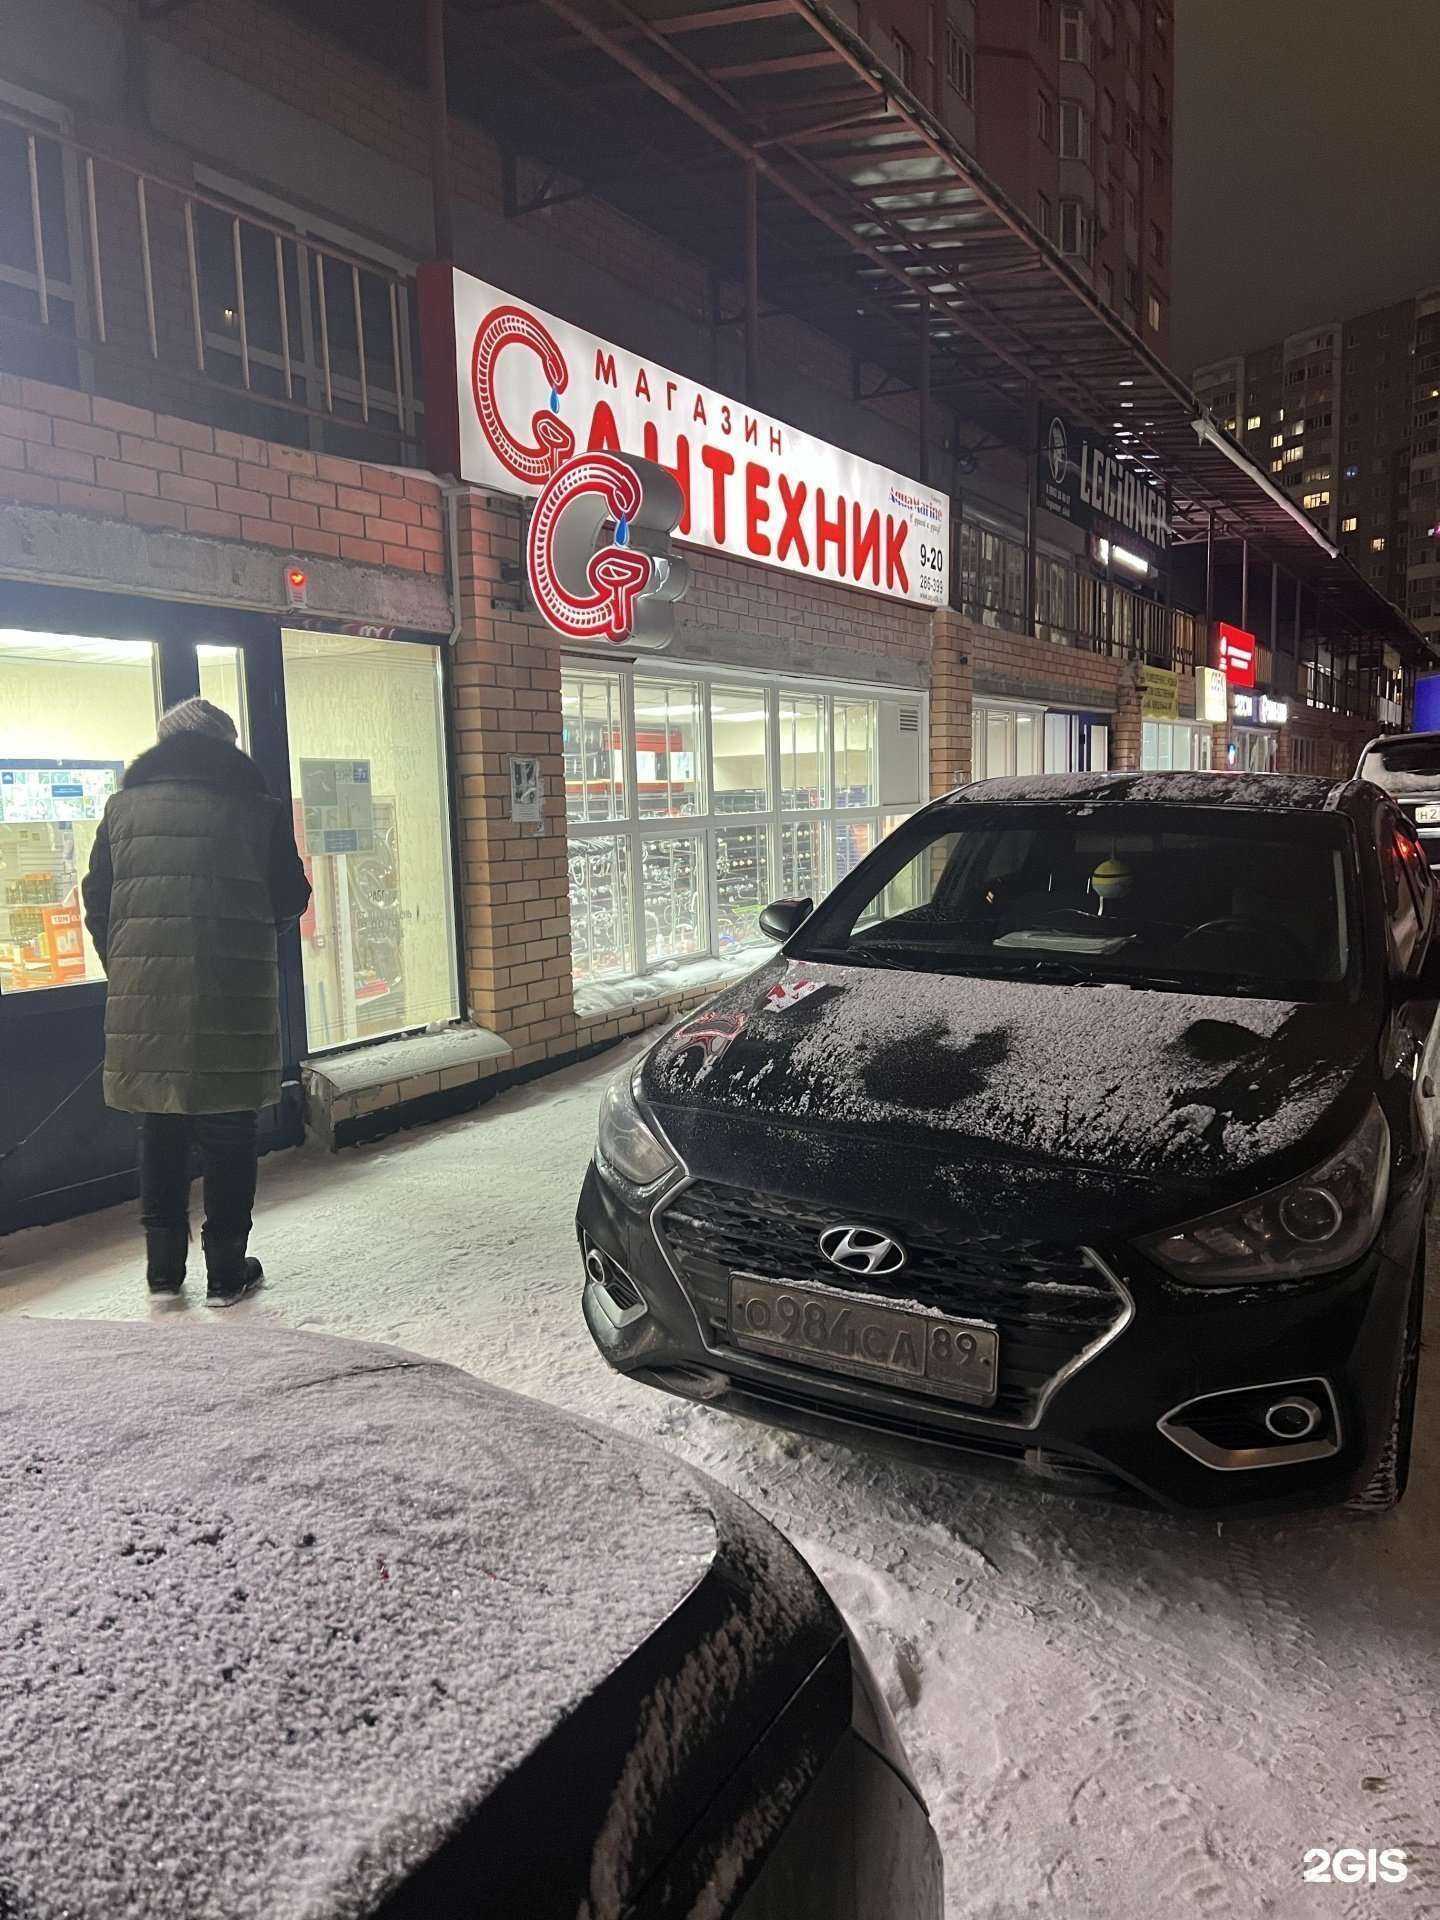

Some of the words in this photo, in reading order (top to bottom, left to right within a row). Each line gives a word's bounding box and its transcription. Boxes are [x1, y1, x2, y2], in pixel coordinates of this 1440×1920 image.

[594, 348, 784, 457] МАГАЗИН
[920, 543, 943, 572] 9-20
[930, 1326, 978, 1367] 89
